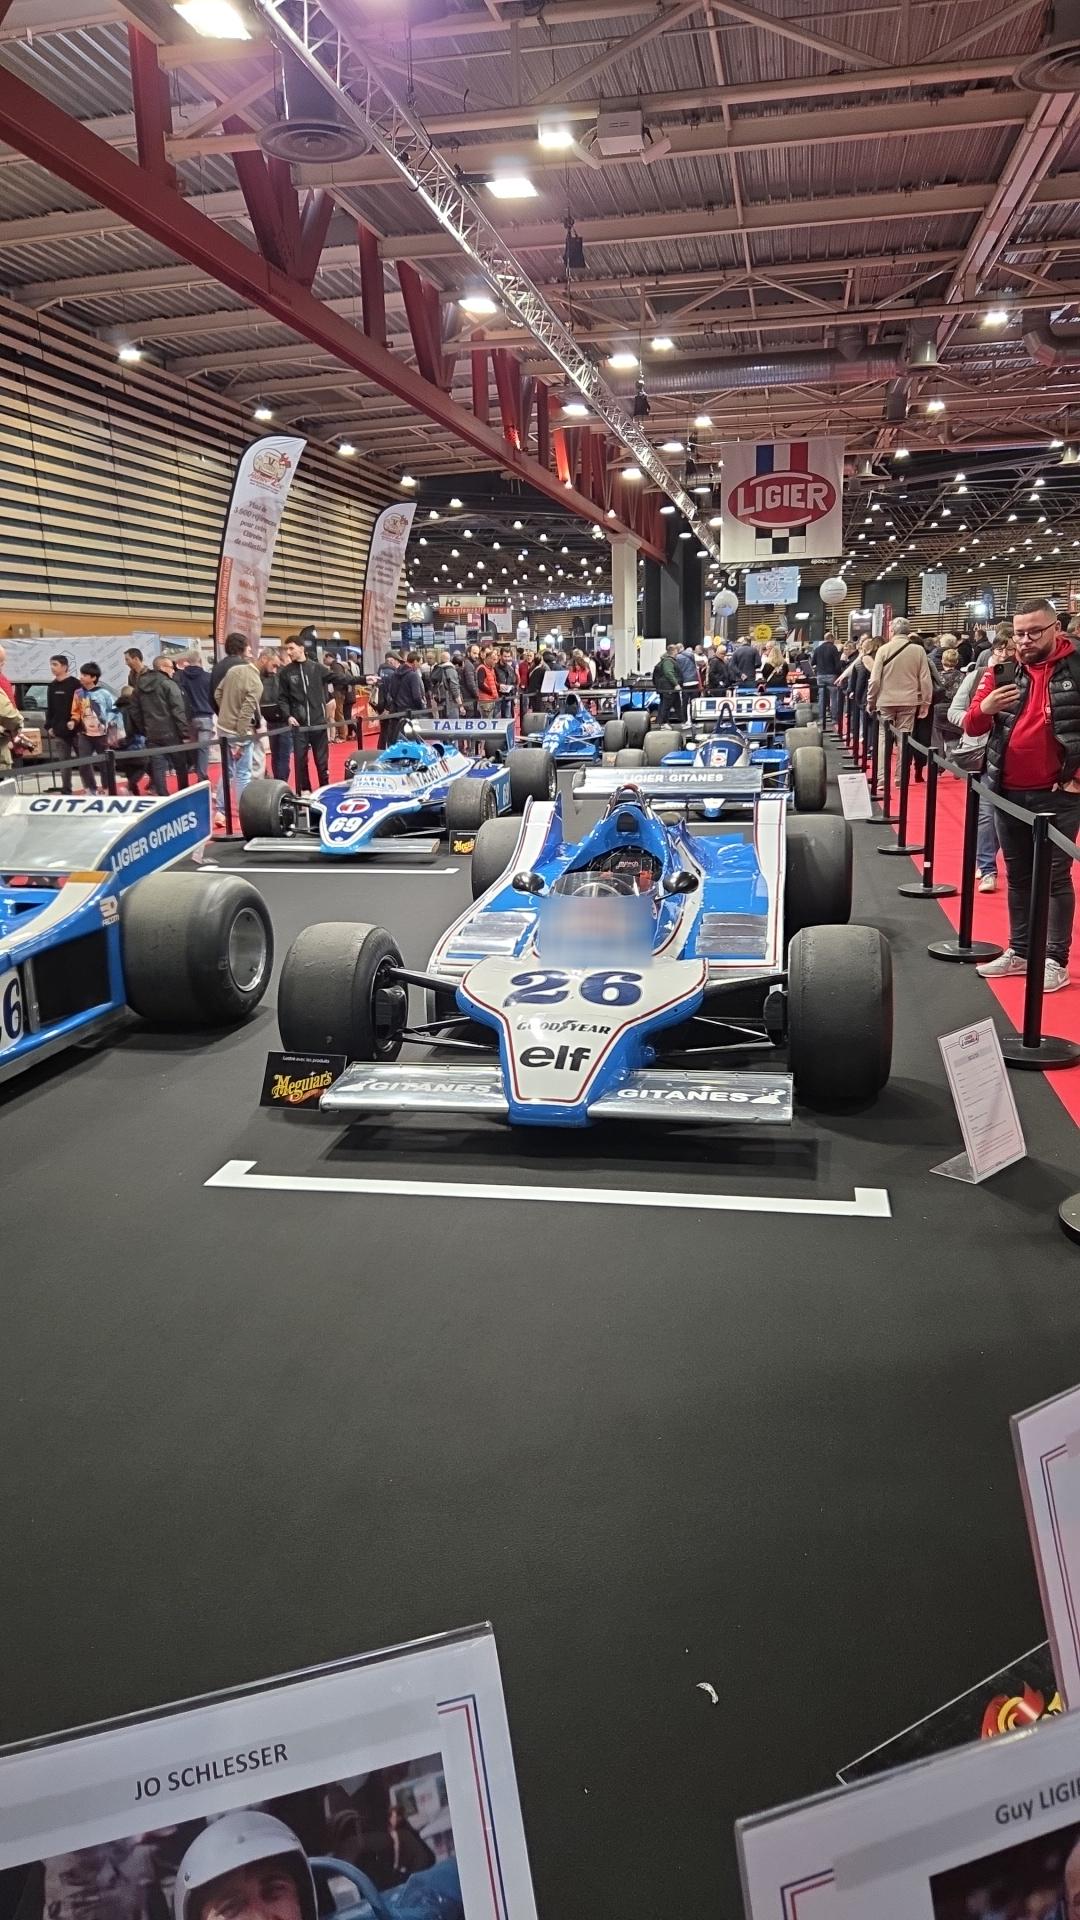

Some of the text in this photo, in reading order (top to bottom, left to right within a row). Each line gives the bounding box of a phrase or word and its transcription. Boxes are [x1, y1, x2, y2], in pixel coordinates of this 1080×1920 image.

[737, 482, 828, 516] LIGIER
[433, 720, 499, 731] TALBOT
[624, 773, 725, 784] LIGIER GITANES
[29, 798, 158, 813] GITANE
[328, 816, 363, 833] 69
[110, 810, 198, 874] LIGIER GITANES
[502, 969, 644, 1009] 26
[3, 977, 22, 1039] 6
[519, 1045, 592, 1072] elf
[271, 1070, 333, 1100] Meguiar's
[370, 1080, 491, 1094] GITANES
[617, 1088, 749, 1103] GITANES
[134, 1743, 289, 1801] JO SCHLESSER
[995, 1798, 1033, 1824] Guy
